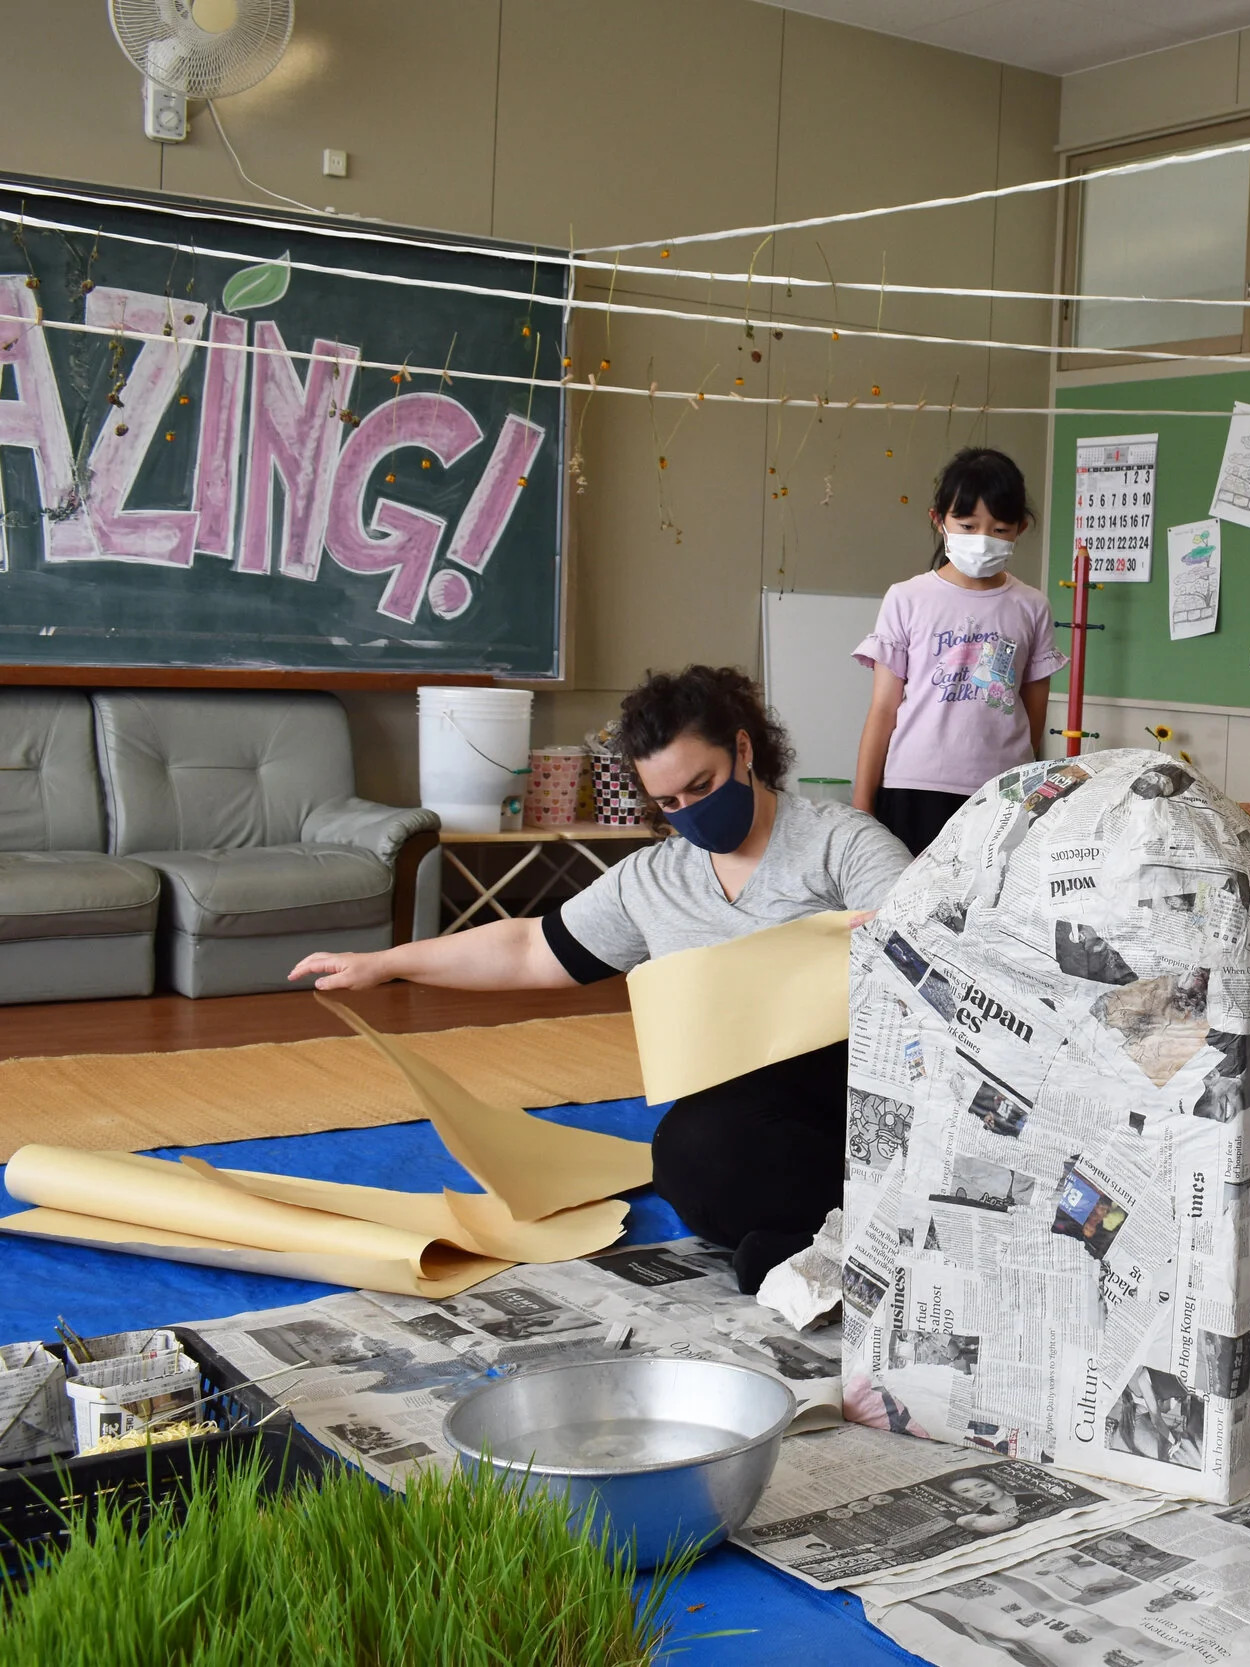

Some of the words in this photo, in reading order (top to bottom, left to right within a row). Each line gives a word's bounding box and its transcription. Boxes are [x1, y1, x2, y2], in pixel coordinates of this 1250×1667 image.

[1142, 492, 1151, 506] 10
[1076, 516, 1083, 528] 11
[1086, 516, 1095, 528] 12
[1097, 516, 1106, 528] 13
[1108, 516, 1117, 528] 14
[1119, 515, 1128, 528] 15
[1130, 515, 1139, 528] 16
[1141, 514, 1150, 527] 17
[1084, 537, 1094, 550] 19
[1095, 537, 1106, 550] 20
[1106, 537, 1116, 550] 21
[1117, 536, 1127, 549] 22
[1128, 536, 1138, 549] 23
[1138, 536, 1149, 549] 24
[1094, 559, 1104, 571] 27
[1105, 558, 1115, 571] 28
[1116, 558, 1126, 571] 29
[1126, 558, 1137, 571] 30
[933, 631, 999, 656] Flowers
[937, 684, 979, 704] Talk!
[1050, 847, 1100, 862] defectors
[1050, 876, 1096, 898] world
[1222, 966, 1246, 975] When
[962, 985, 1034, 1044] Japan
[958, 1030, 981, 1054] Times
[1226, 1140, 1234, 1154] fear
[1234, 1135, 1244, 1168] hospitals
[1084, 1160, 1111, 1183] makes
[1224, 1158, 1234, 1178] Deep
[1109, 1181, 1138, 1207] Harris
[891, 1266, 906, 1331] usiness
[930, 1284, 942, 1326] almost
[917, 1301, 928, 1324] fuel
[944, 1309, 954, 1335] 2019
[1181, 1301, 1196, 1336] Kong
[1179, 1336, 1194, 1370] Hong
[1178, 1370, 1189, 1382] to
[1074, 1358, 1098, 1443] Culture
[1214, 1422, 1225, 1456] honor
[1212, 1460, 1223, 1477] An
